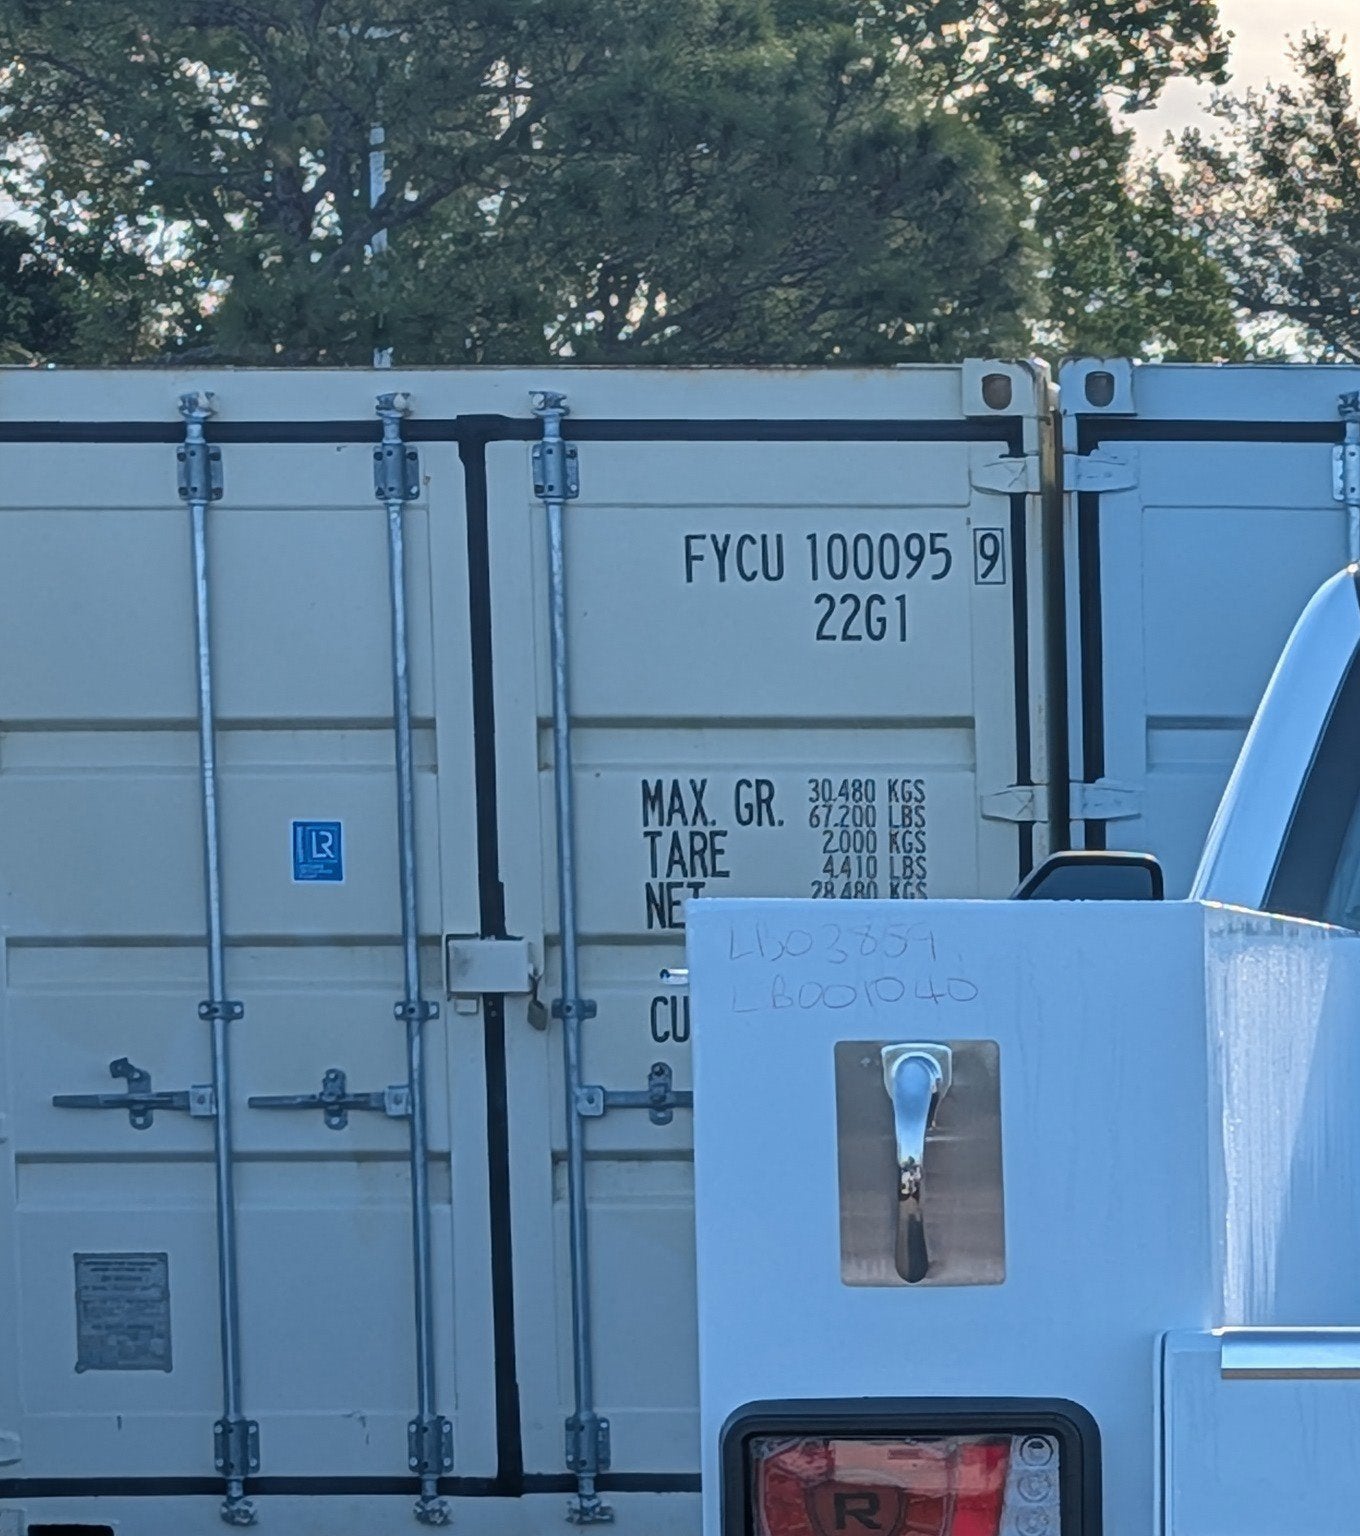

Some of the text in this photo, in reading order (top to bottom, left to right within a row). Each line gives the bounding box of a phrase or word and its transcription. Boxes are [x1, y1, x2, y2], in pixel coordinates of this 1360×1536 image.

[684, 531, 1001, 583] FYCU 100095 9
[813, 593, 907, 642] 22G1
[641, 778, 926, 828] MAX. GR. 30.480 KGS
[808, 804, 926, 829] 67.200 LBS
[643, 830, 731, 879] TARE
[888, 829, 927, 854] KGS
[822, 854, 928, 879] 4.410 LBS
[811, 879, 878, 899] 28480
[833, 1492, 882, 1530] R
